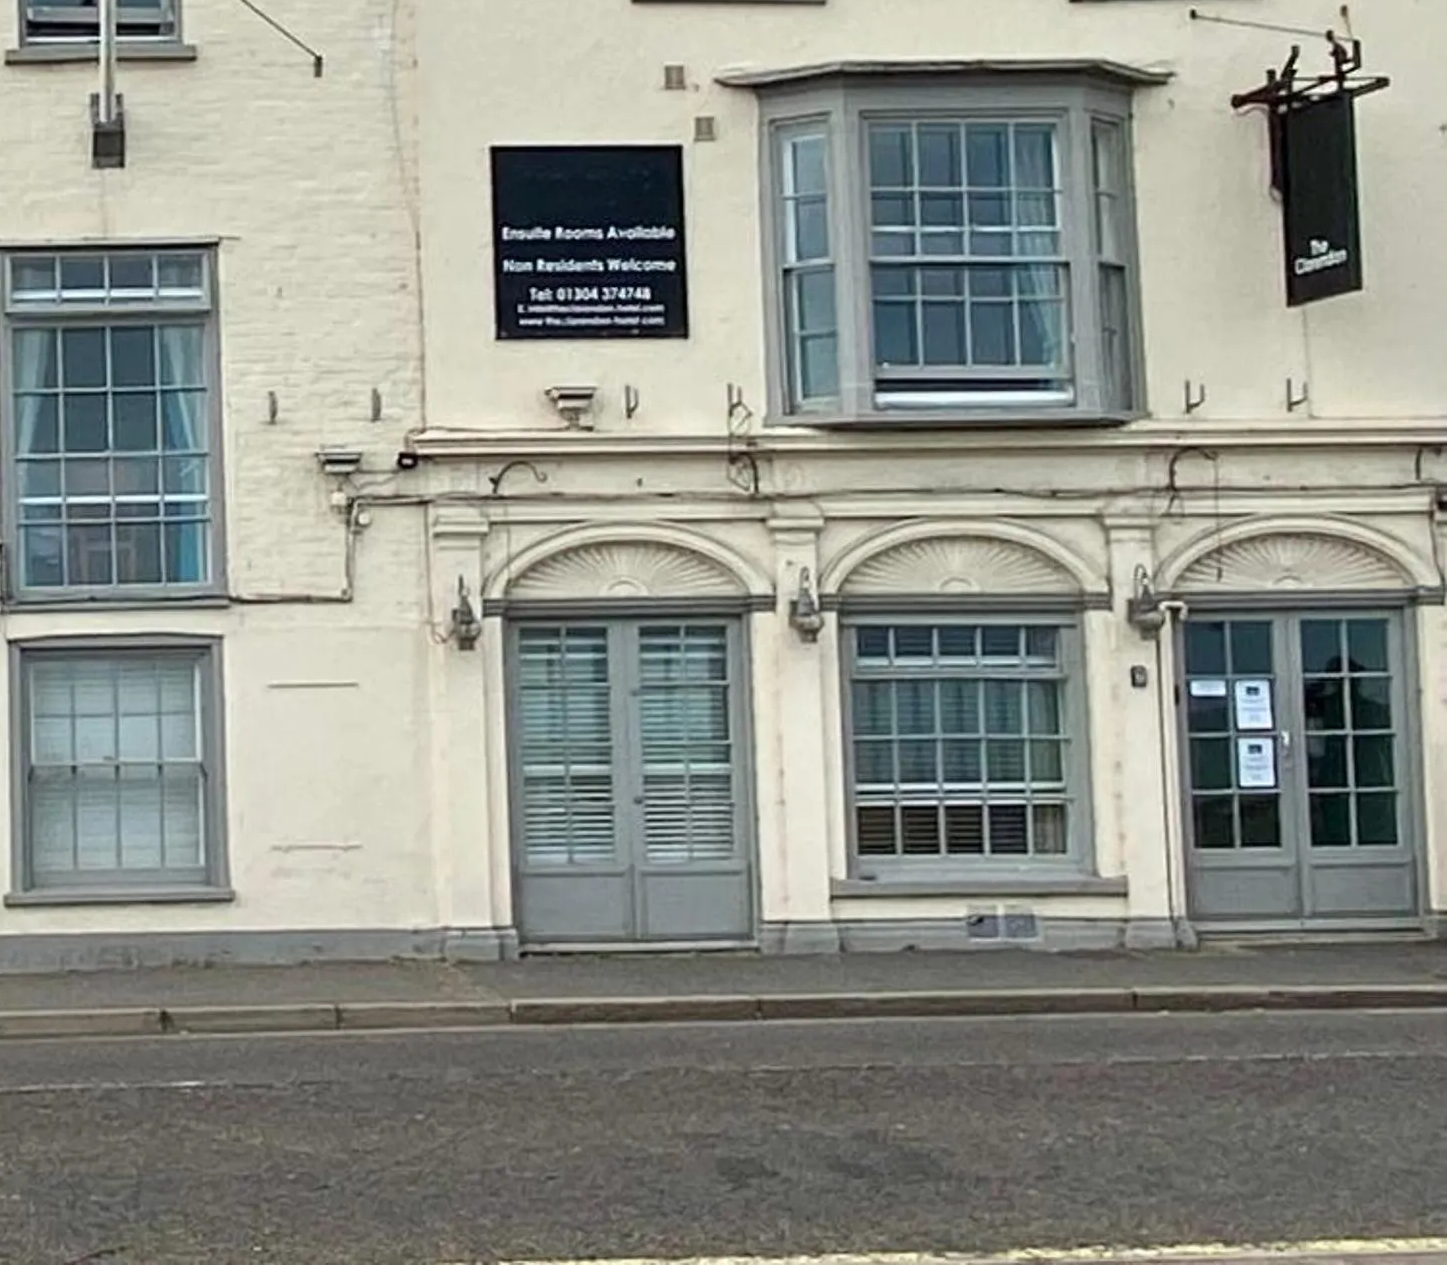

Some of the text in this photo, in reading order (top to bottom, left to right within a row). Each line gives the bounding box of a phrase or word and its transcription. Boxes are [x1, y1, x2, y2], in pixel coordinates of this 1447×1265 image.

[555, 226, 603, 240] Rooms
[607, 225, 675, 240] Available
[503, 258, 676, 272] Non Residents Welcome
[556, 287, 599, 301] 01304
